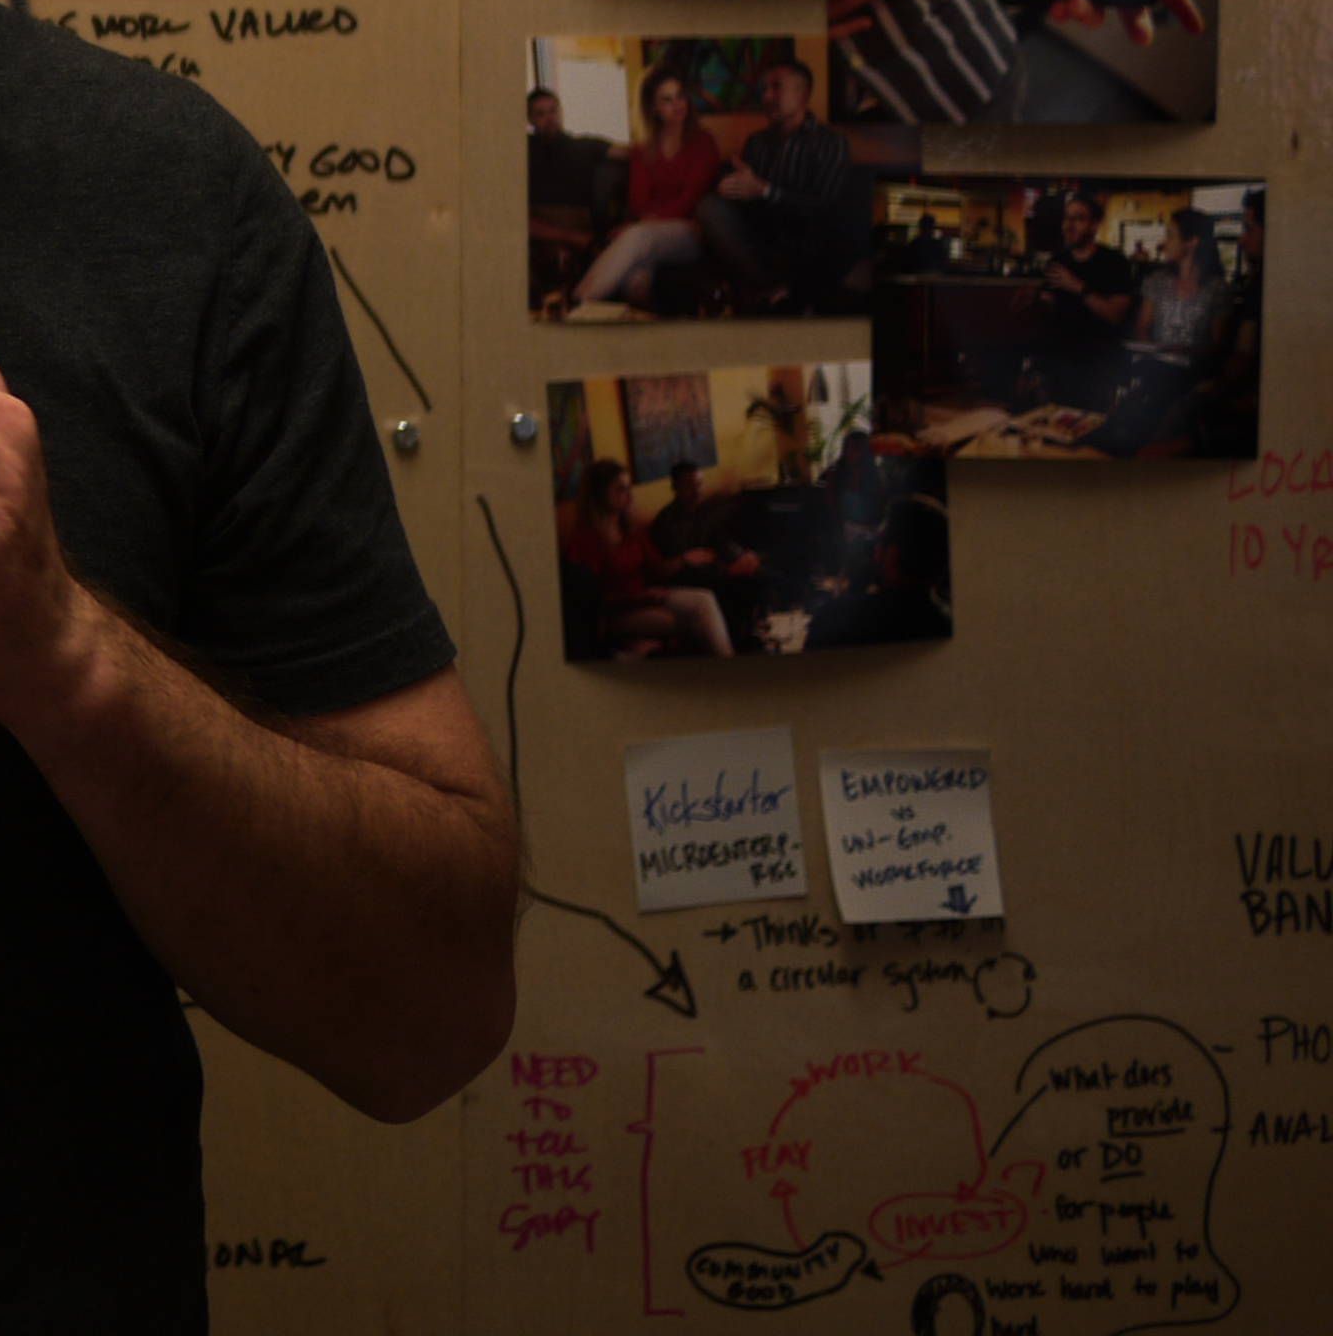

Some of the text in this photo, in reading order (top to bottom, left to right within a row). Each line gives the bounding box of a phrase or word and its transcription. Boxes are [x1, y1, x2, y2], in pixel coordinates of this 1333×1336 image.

[210, 5, 359, 44] VALUED
[308, 143, 418, 184] GOOD
[1229, 521, 1267, 579] 10
[839, 765, 989, 803] EMPOWERED
[509, 1051, 601, 1089] NEED
[804, 1047, 923, 1085] WORK
[520, 1095, 575, 1122] TO
[1106, 1095, 1197, 1132] provide
[739, 1140, 812, 1180] PLAY
[1056, 1141, 1144, 1171] or DO
[892, 1205, 1017, 1245] INVEST
[1054, 1193, 1096, 1221] for
[1175, 1239, 1200, 1263] to
